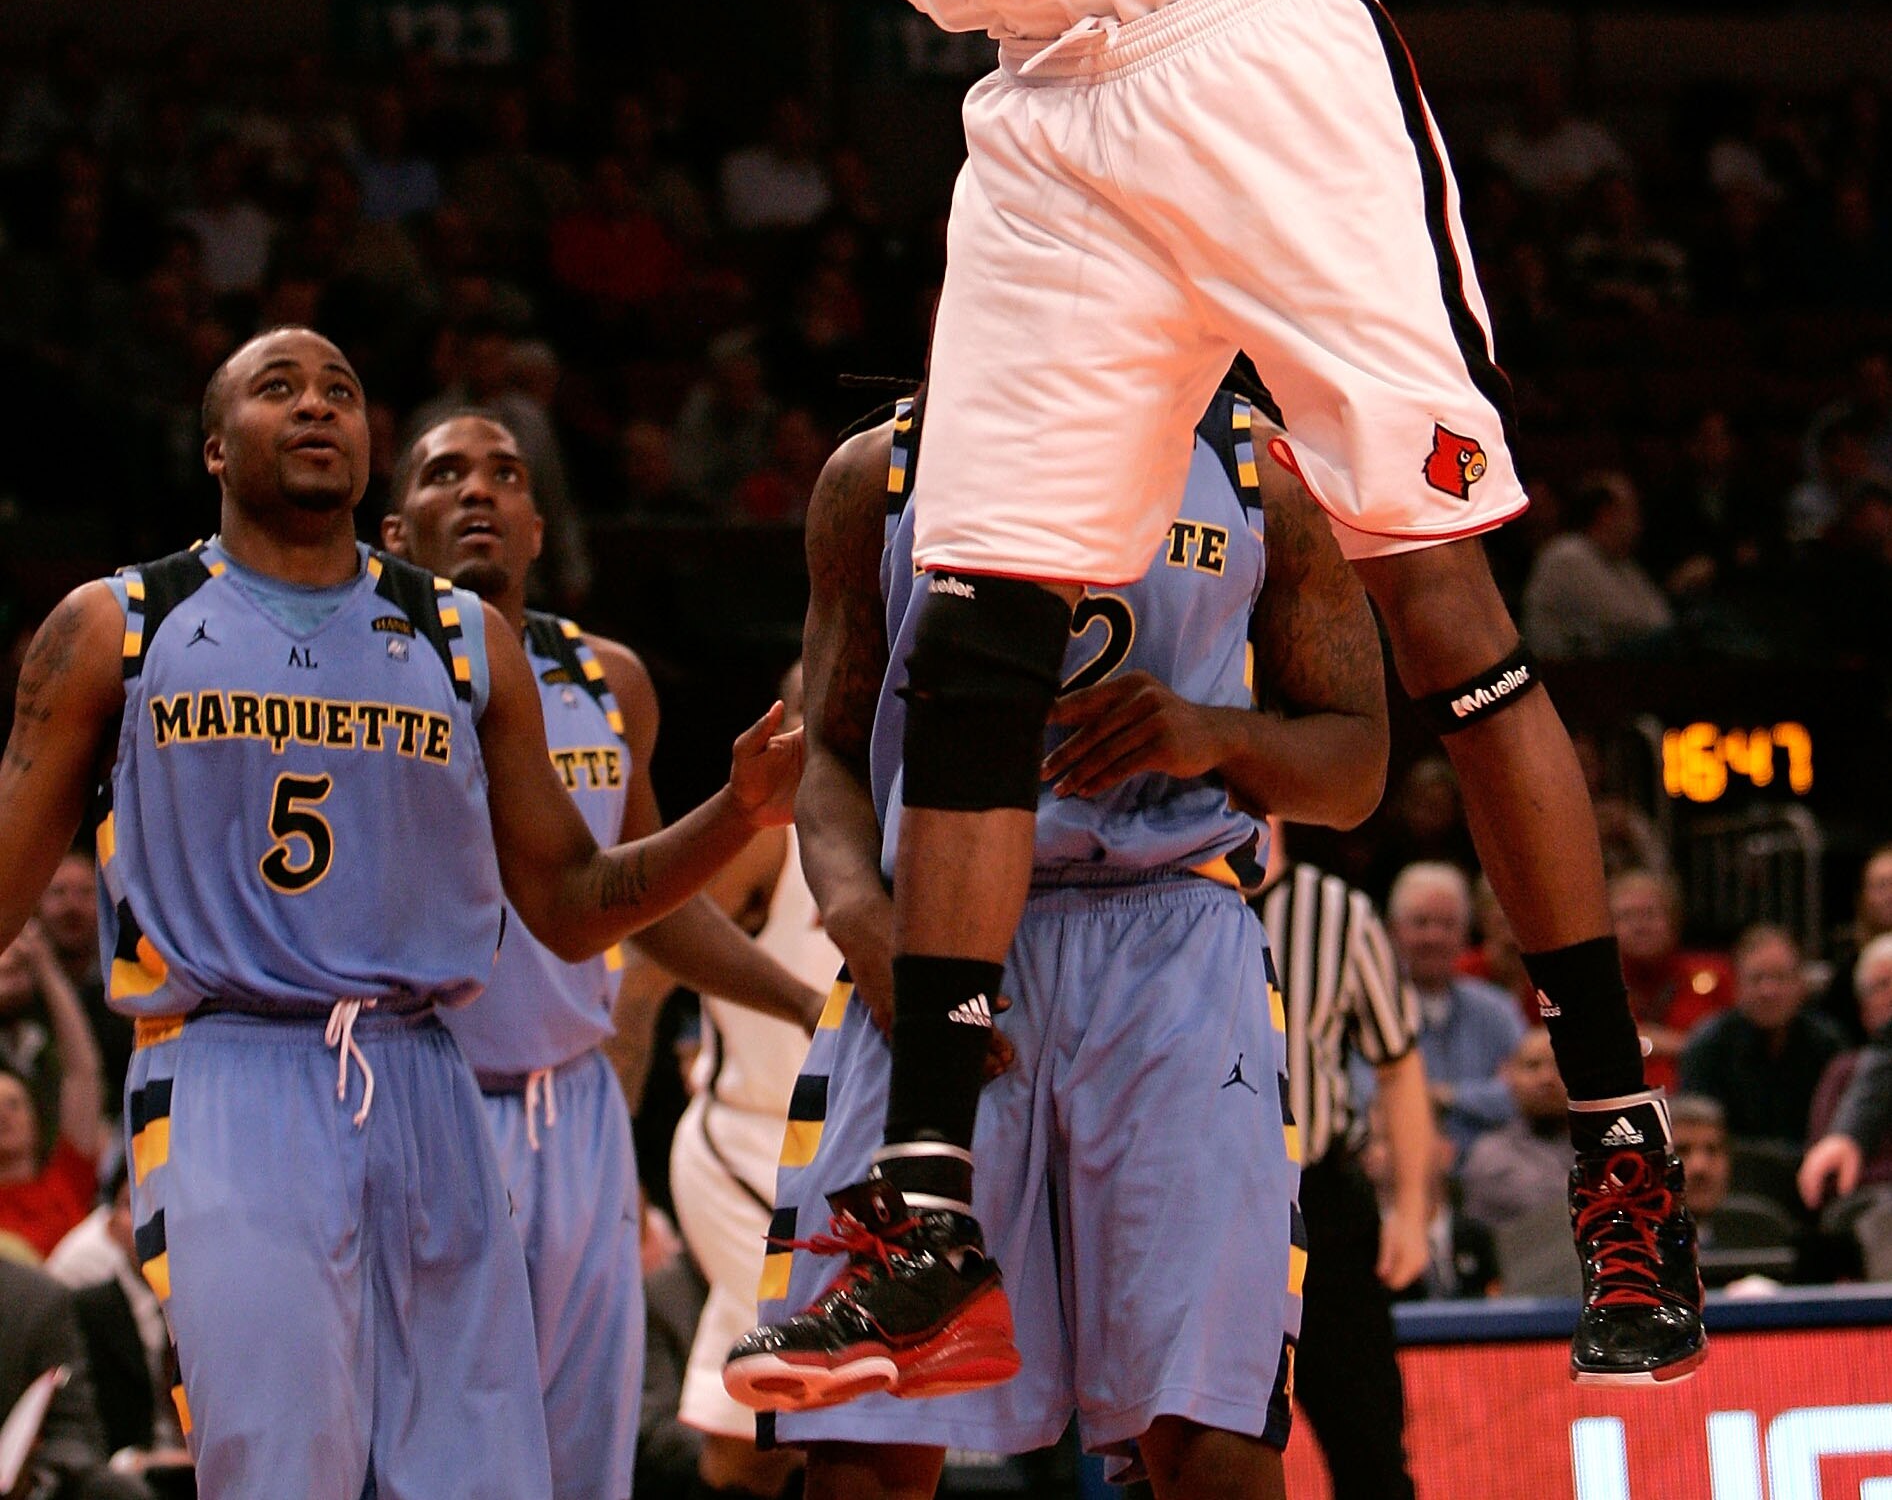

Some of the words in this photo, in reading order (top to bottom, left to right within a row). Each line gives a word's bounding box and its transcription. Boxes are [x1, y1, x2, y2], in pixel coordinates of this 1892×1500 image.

[928, 576, 976, 600] ueller
[1459, 665, 1530, 712] Mueller
[150, 687, 450, 764] MARQUETTE
[259, 771, 334, 894] 5
